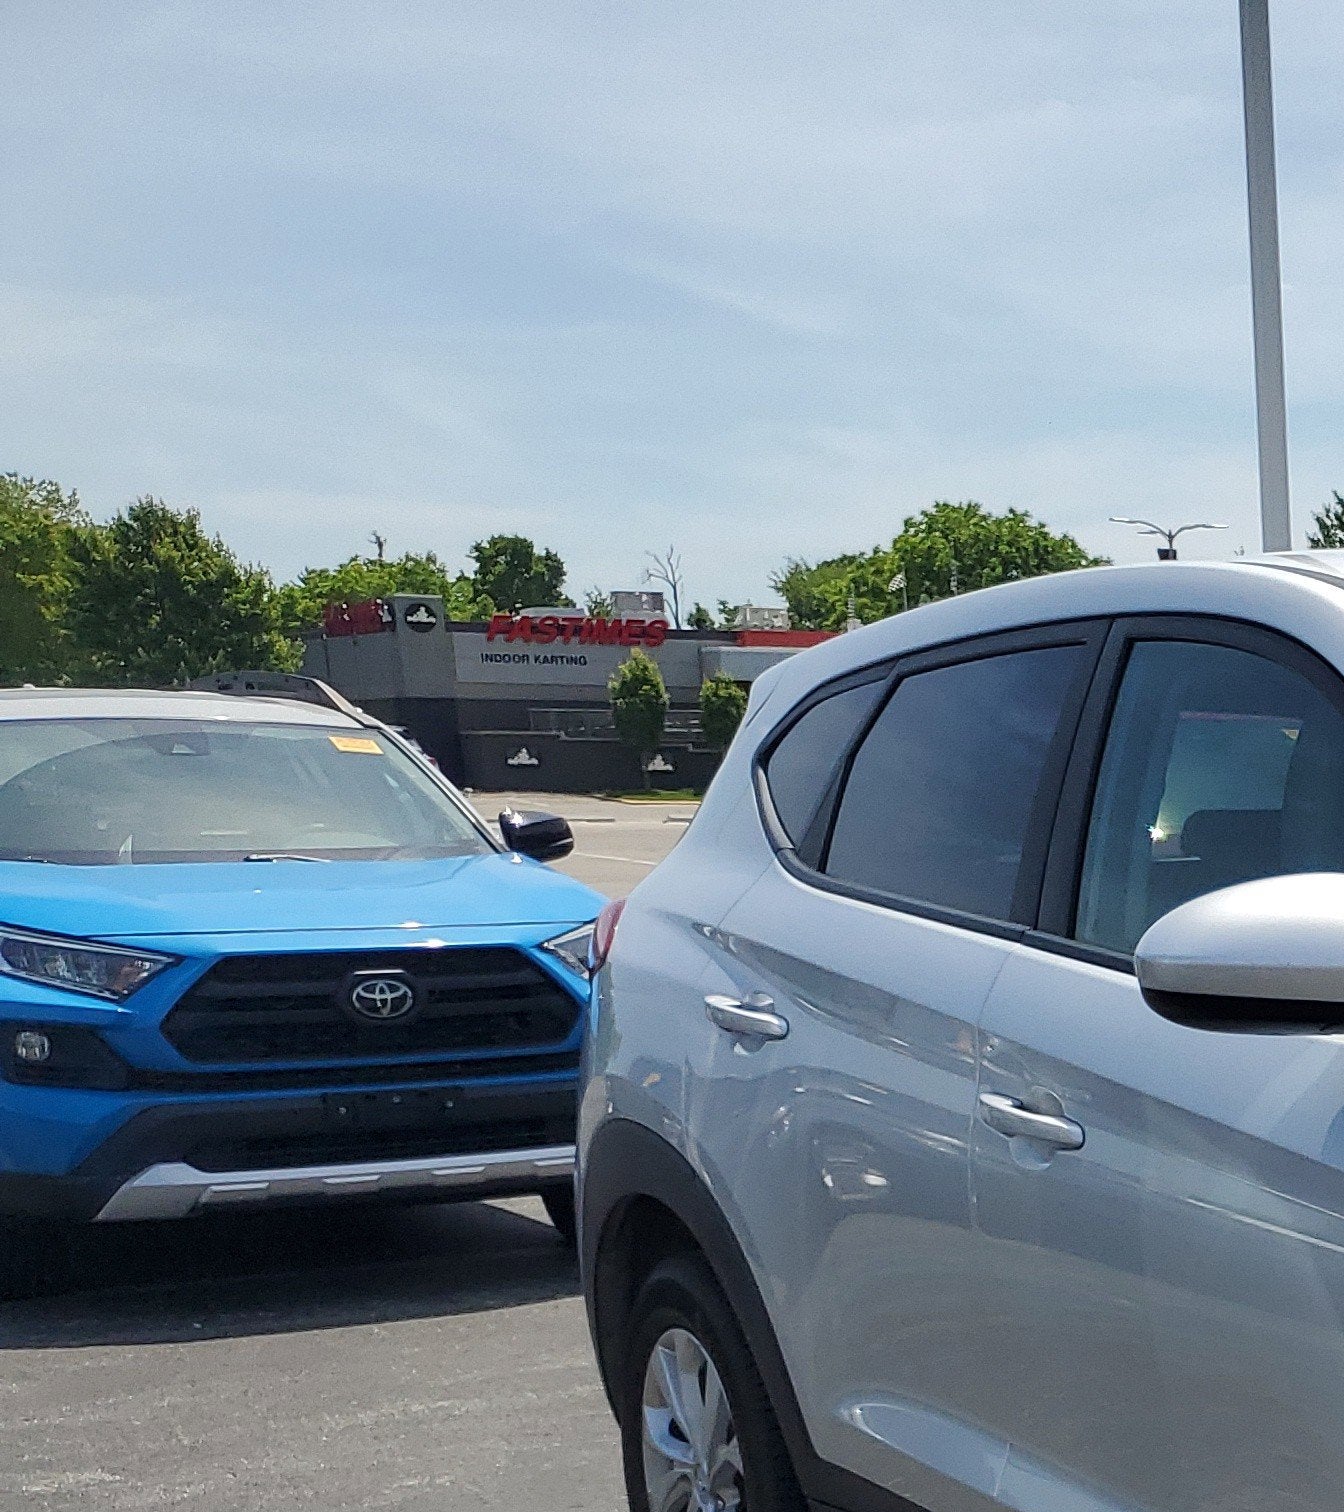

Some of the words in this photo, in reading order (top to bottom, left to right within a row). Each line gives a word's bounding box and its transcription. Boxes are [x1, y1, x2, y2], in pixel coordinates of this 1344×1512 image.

[486, 615, 670, 648] FASTIMES
[480, 652, 530, 664] INDOOR
[534, 653, 588, 666] KARTING
